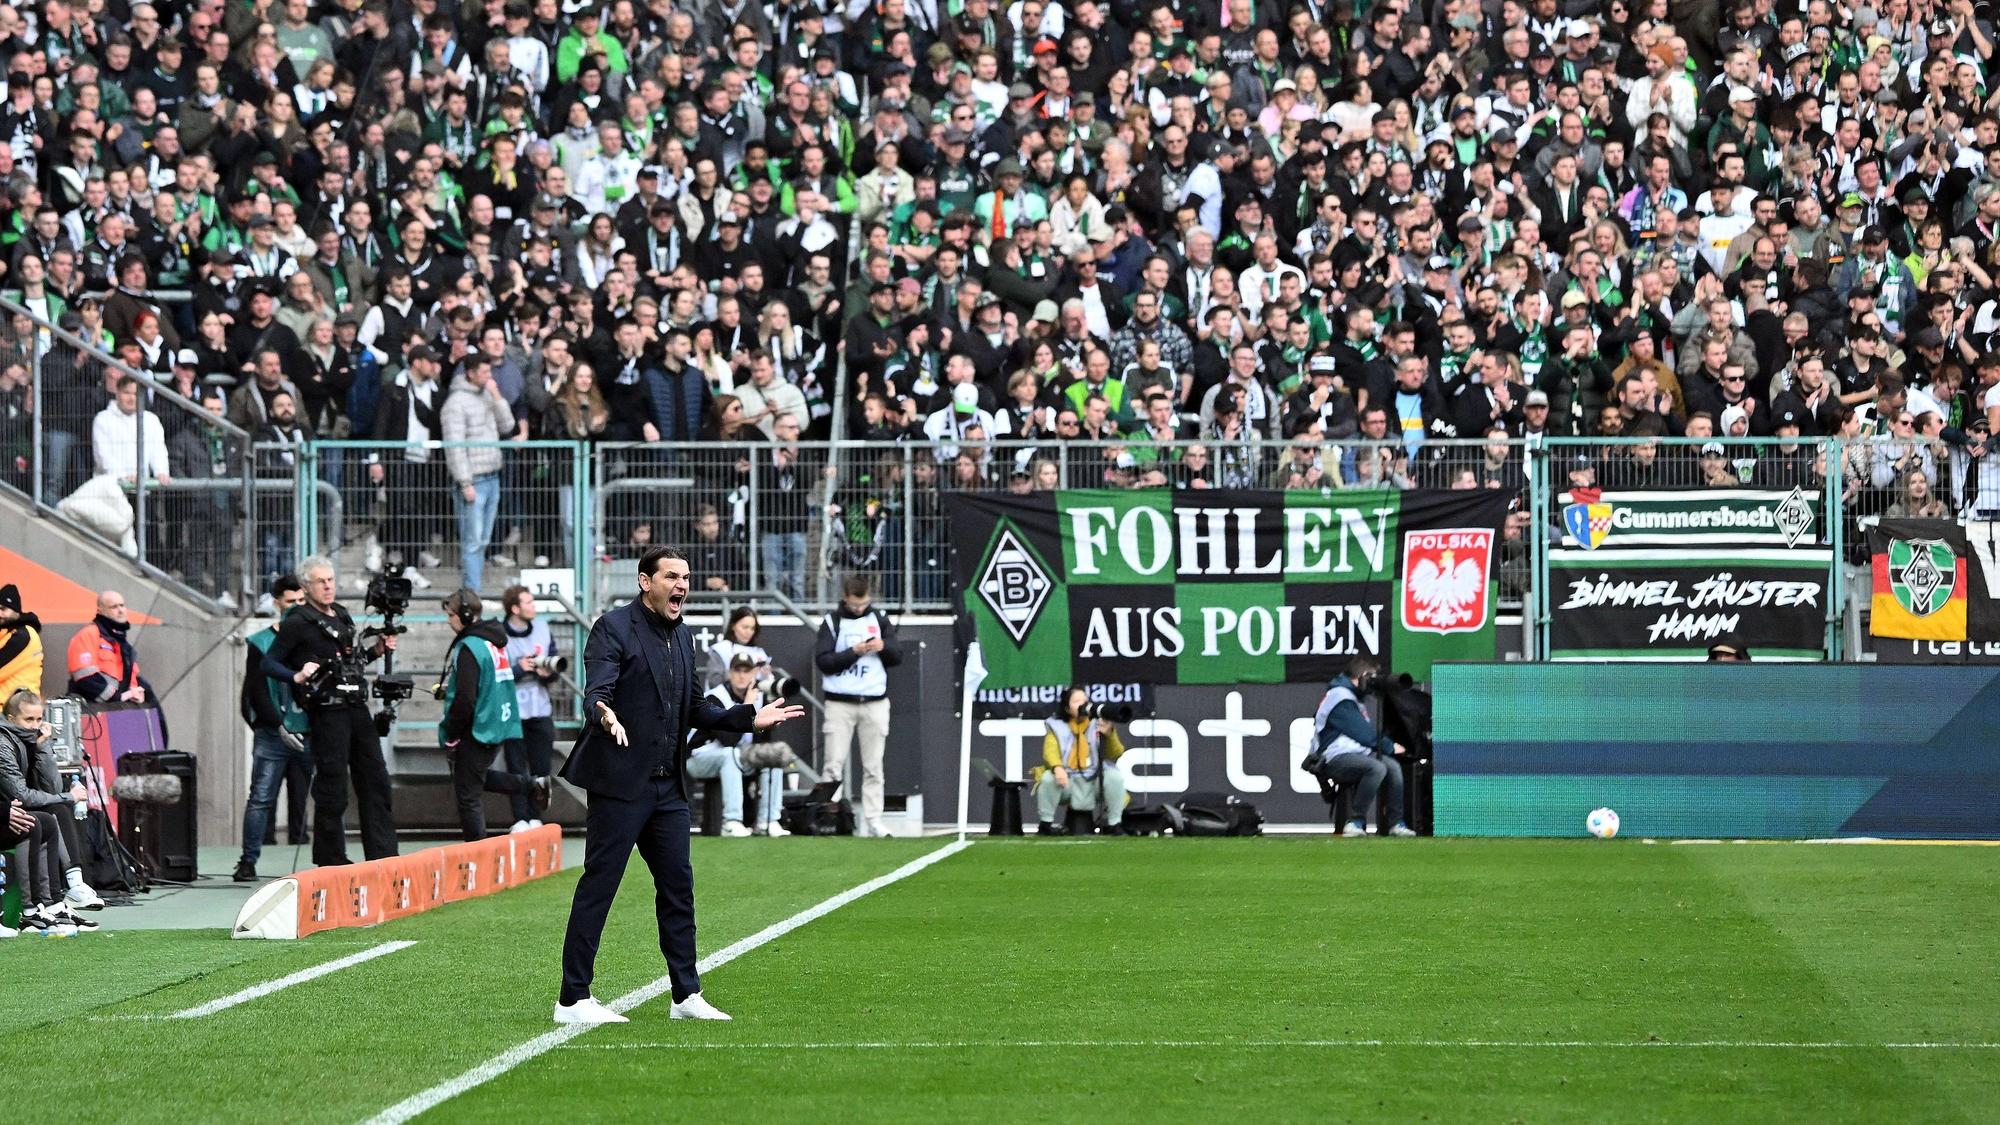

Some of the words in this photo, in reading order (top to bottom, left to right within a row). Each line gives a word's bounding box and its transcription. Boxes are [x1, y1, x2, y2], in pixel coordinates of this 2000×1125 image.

[1612, 505, 1775, 529] Gummersbach
[1066, 506, 1393, 576] FOHLEN
[1409, 534, 1487, 550] POLSKA
[1687, 572, 1821, 609] JÄUSTER
[1079, 606, 1185, 658] AUS
[1200, 604, 1384, 656] POLEN
[1646, 608, 1740, 644] HAMM
